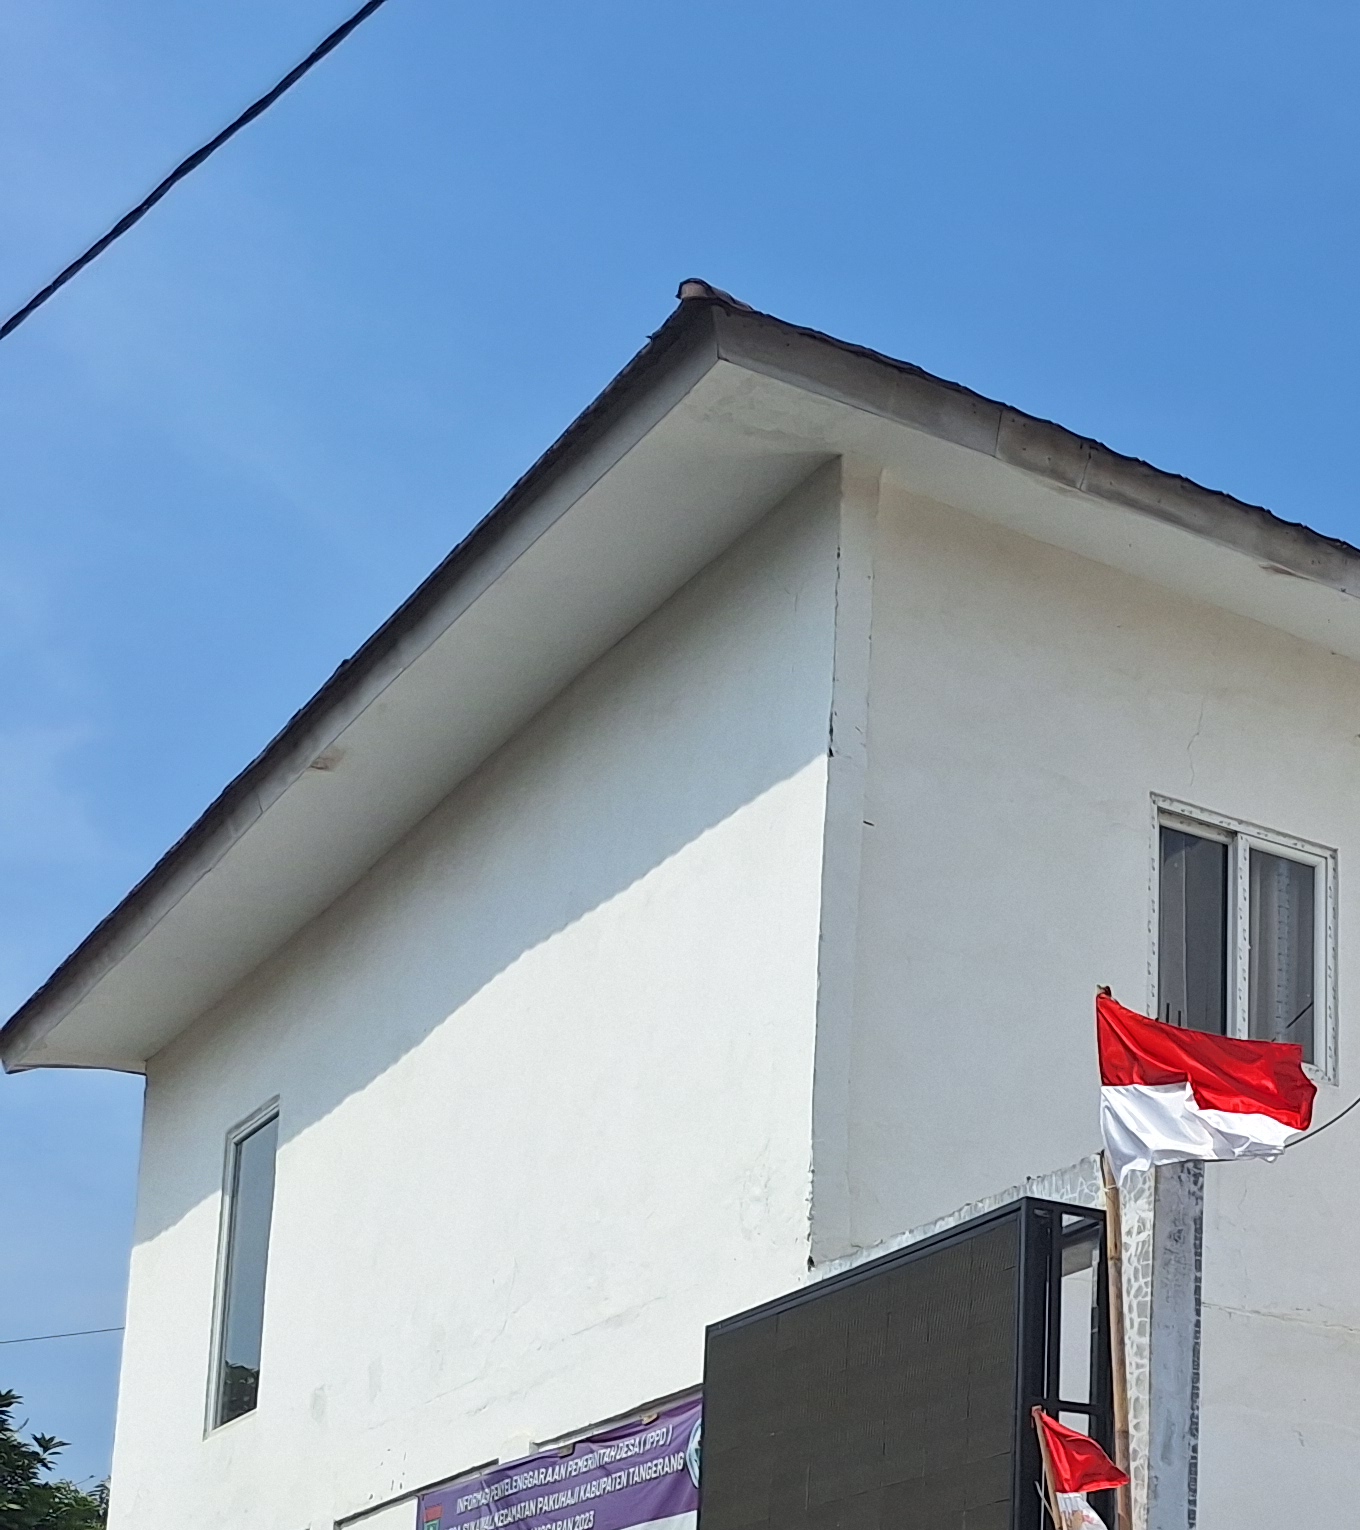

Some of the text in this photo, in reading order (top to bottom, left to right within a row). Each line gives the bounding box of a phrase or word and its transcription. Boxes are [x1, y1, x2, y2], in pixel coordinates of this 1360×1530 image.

[536, 1486, 580, 1517] PAKUHAJI
[580, 1469, 629, 1502] KABUPATEN
[628, 1451, 685, 1486] TANGERANG
[567, 1445, 618, 1478] PEMERINTAH
[616, 1437, 640, 1461] DESA
